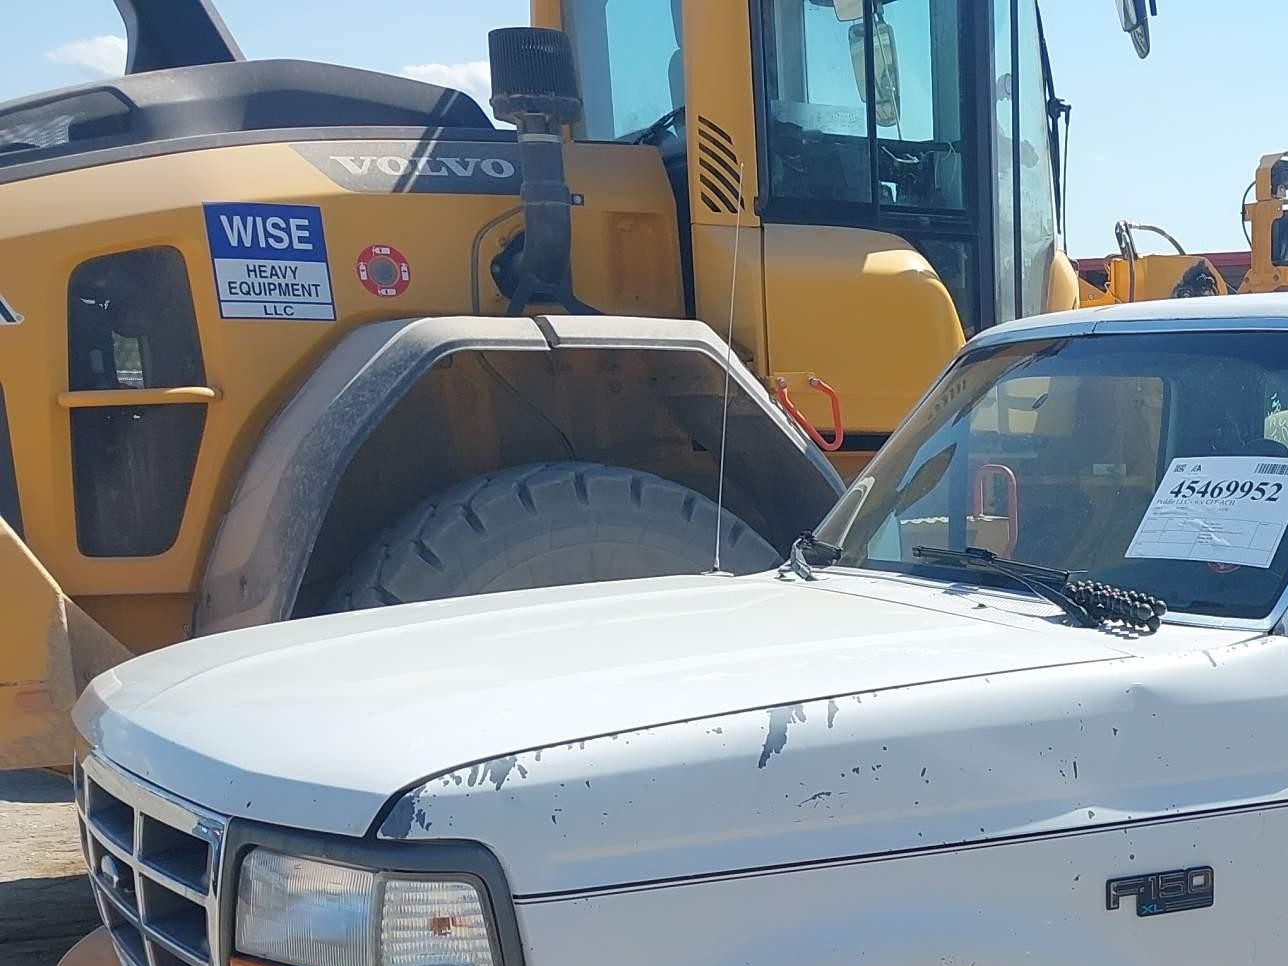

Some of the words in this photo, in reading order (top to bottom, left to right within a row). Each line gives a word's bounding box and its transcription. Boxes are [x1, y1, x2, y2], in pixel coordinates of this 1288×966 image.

[329, 156, 515, 178] VOLVO
[220, 215, 313, 250] WISE
[246, 263, 298, 280] HEAVY
[227, 281, 321, 298] EQUIPMENT
[263, 304, 295, 317] LLC
[1169, 479, 1283, 502] 45469952
[1142, 904, 1163, 913] XL
